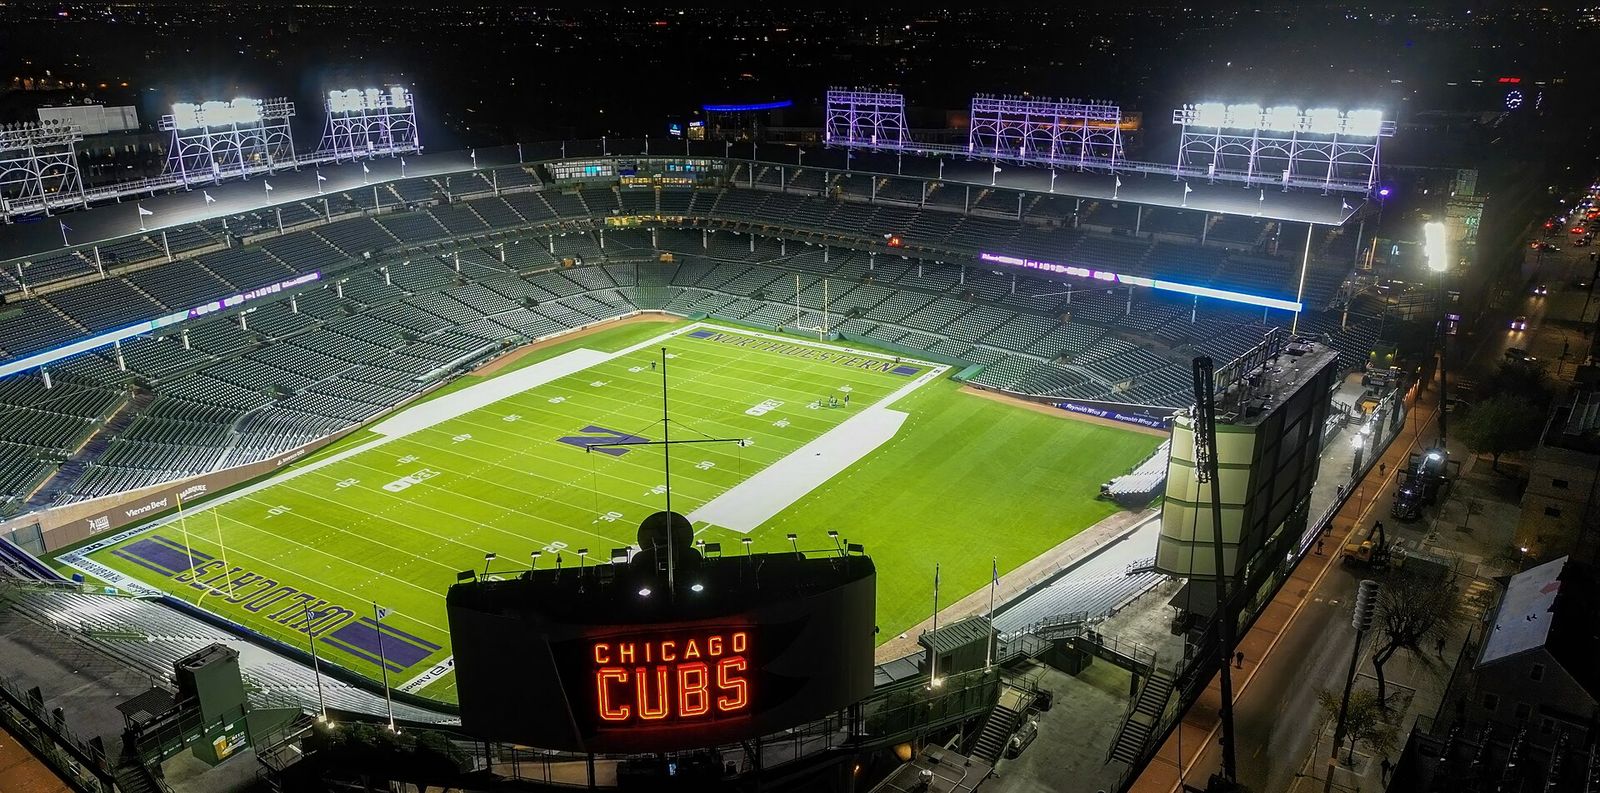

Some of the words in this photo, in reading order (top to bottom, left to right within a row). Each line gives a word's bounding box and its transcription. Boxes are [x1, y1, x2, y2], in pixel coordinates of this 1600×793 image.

[706, 332, 897, 373] NORTHWESTERN
[1066, 403, 1087, 413] Reynolds
[1114, 413, 1138, 423] Reynolds
[556, 425, 651, 457] N
[695, 461, 716, 471] 50
[336, 478, 360, 488] 20
[126, 505, 151, 517] Vienna
[150, 498, 167, 511] Beef
[267, 505, 291, 515] 10
[599, 511, 623, 522] 30
[542, 542, 568, 553] 20
[174, 559, 356, 638] WILDCATS
[595, 632, 746, 663] CHICAGO
[402, 674, 430, 693] Abbot
[597, 656, 747, 721] CUBS
